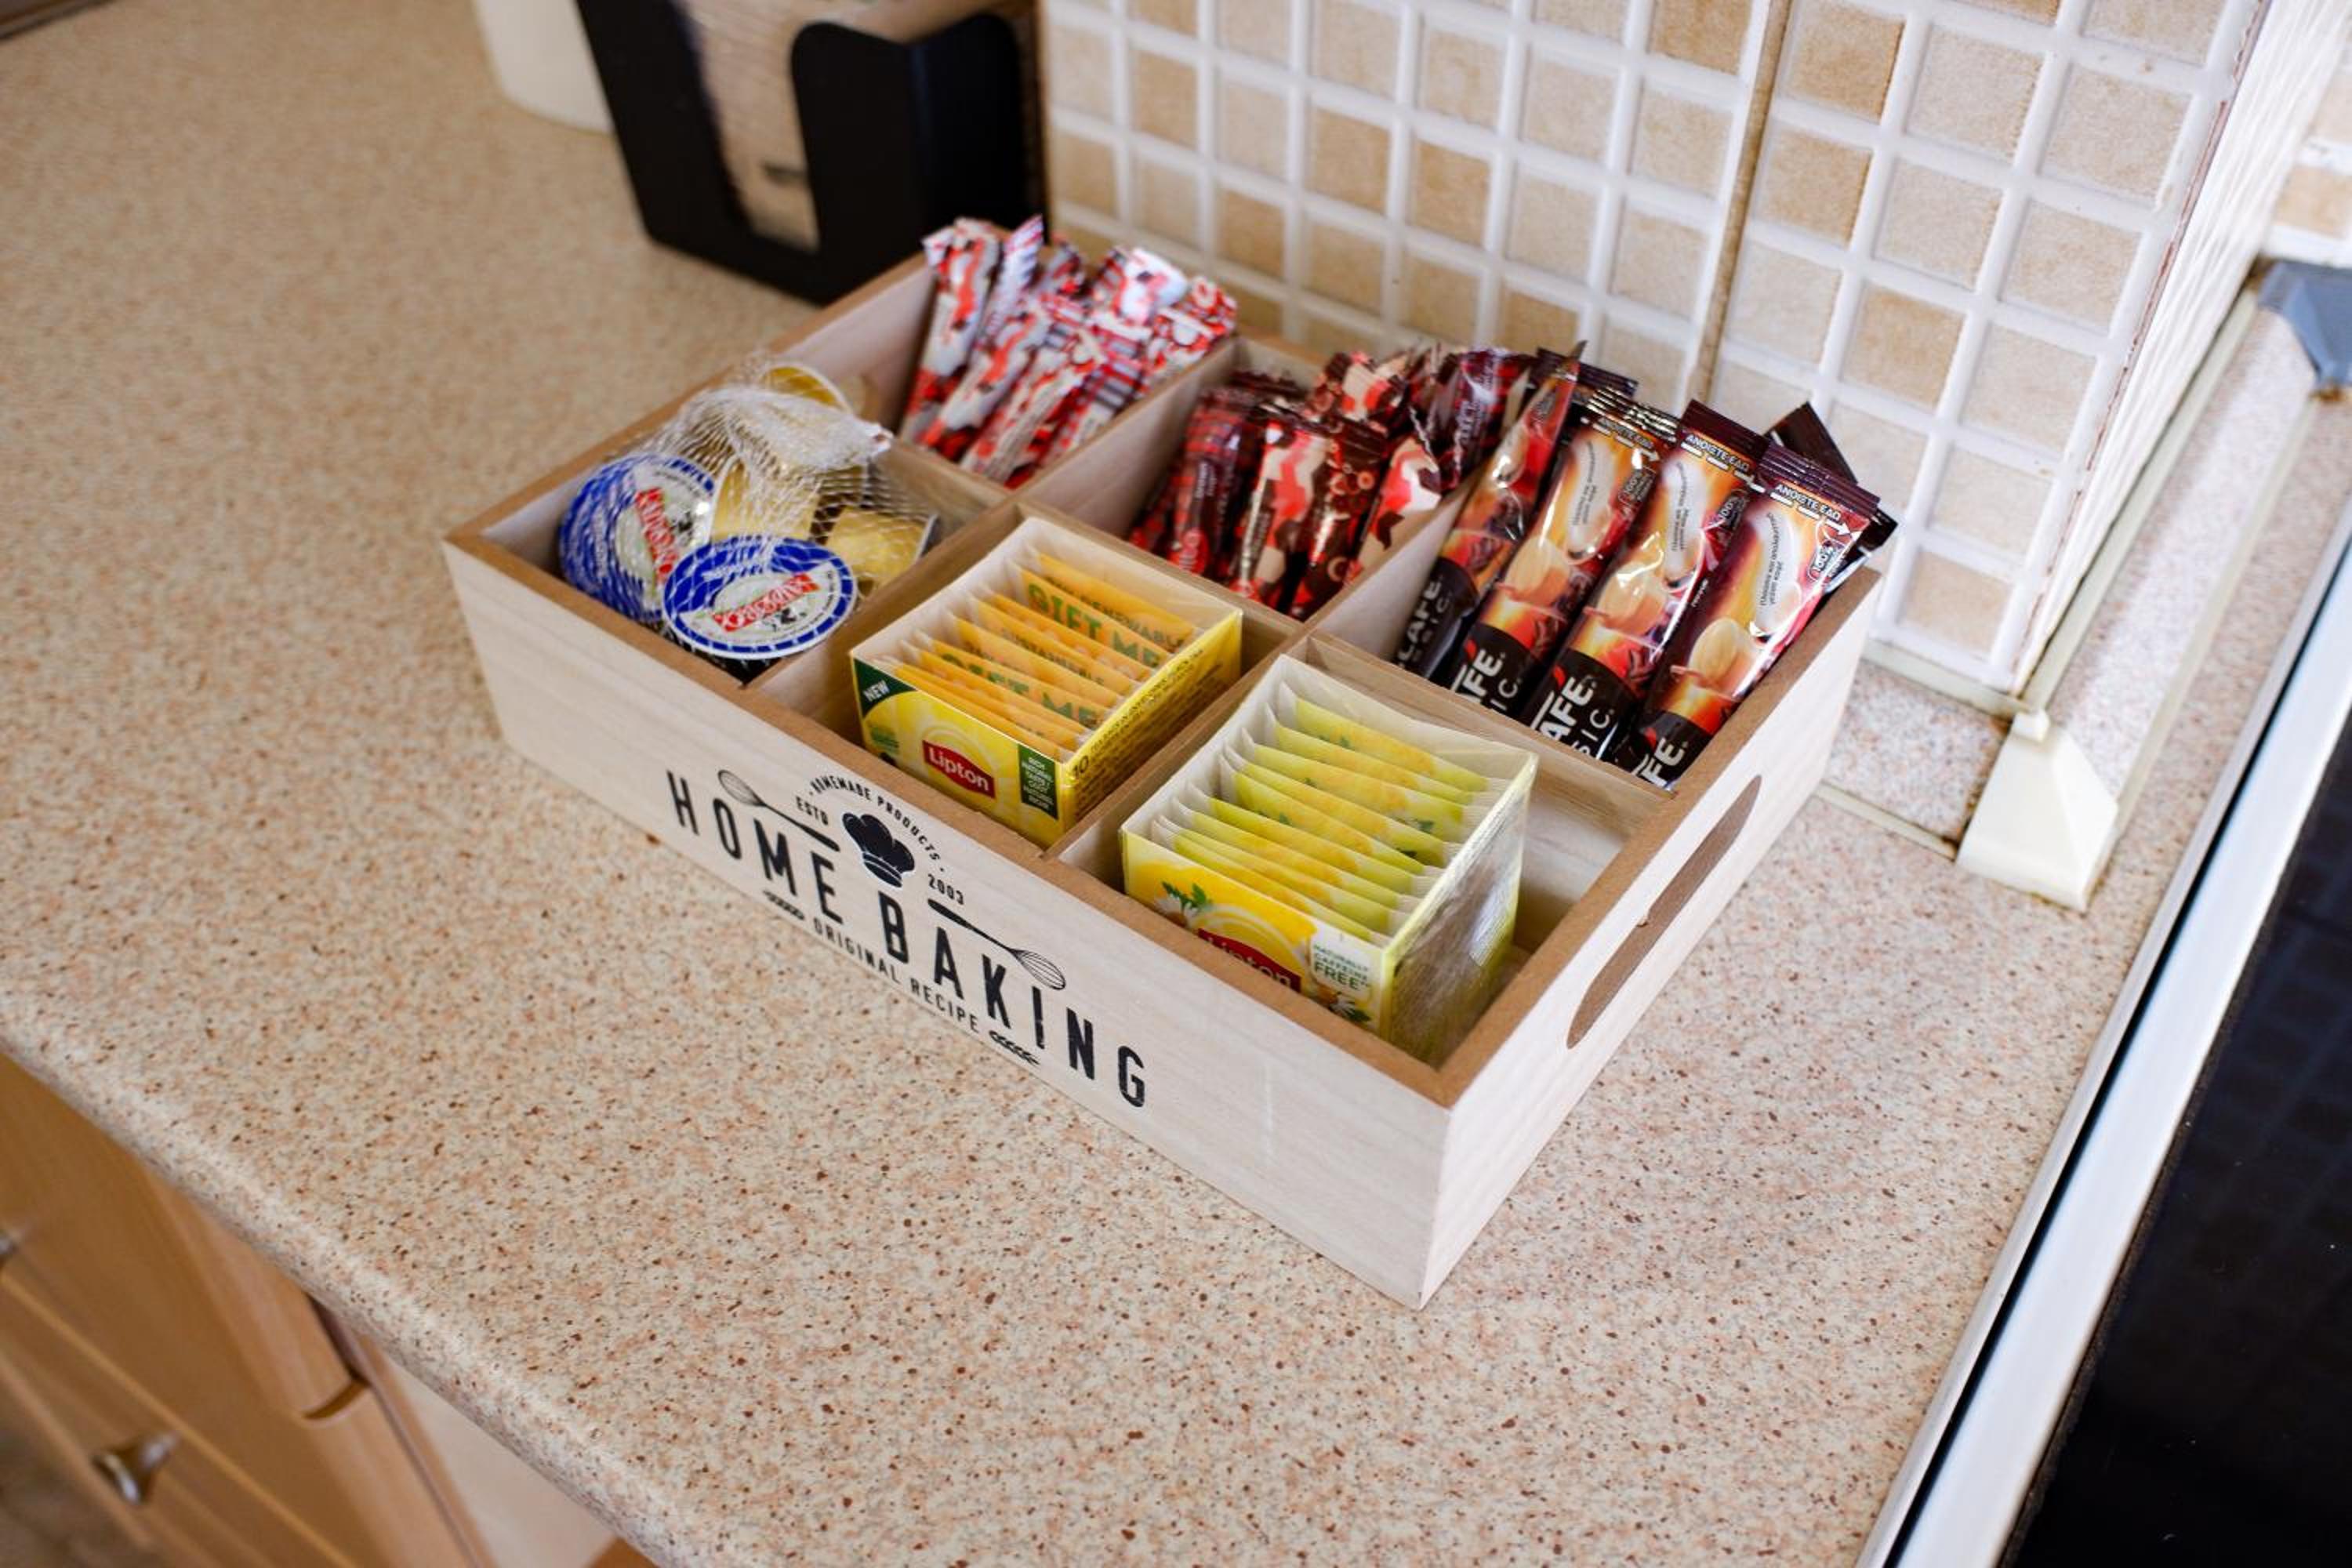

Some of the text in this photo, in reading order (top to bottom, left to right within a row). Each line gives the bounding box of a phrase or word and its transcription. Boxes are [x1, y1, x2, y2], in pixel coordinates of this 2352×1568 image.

[863, 680, 890, 702] NEW
[928, 746, 989, 792] Lipton
[796, 796, 829, 826] ESTD
[810, 775, 941, 861] HOMEMADE PRODUCTS
[927, 873, 964, 906] 2003
[666, 768, 1145, 1108] HOME BAKING
[813, 917, 979, 1034] ORIGINAL RECIPE
